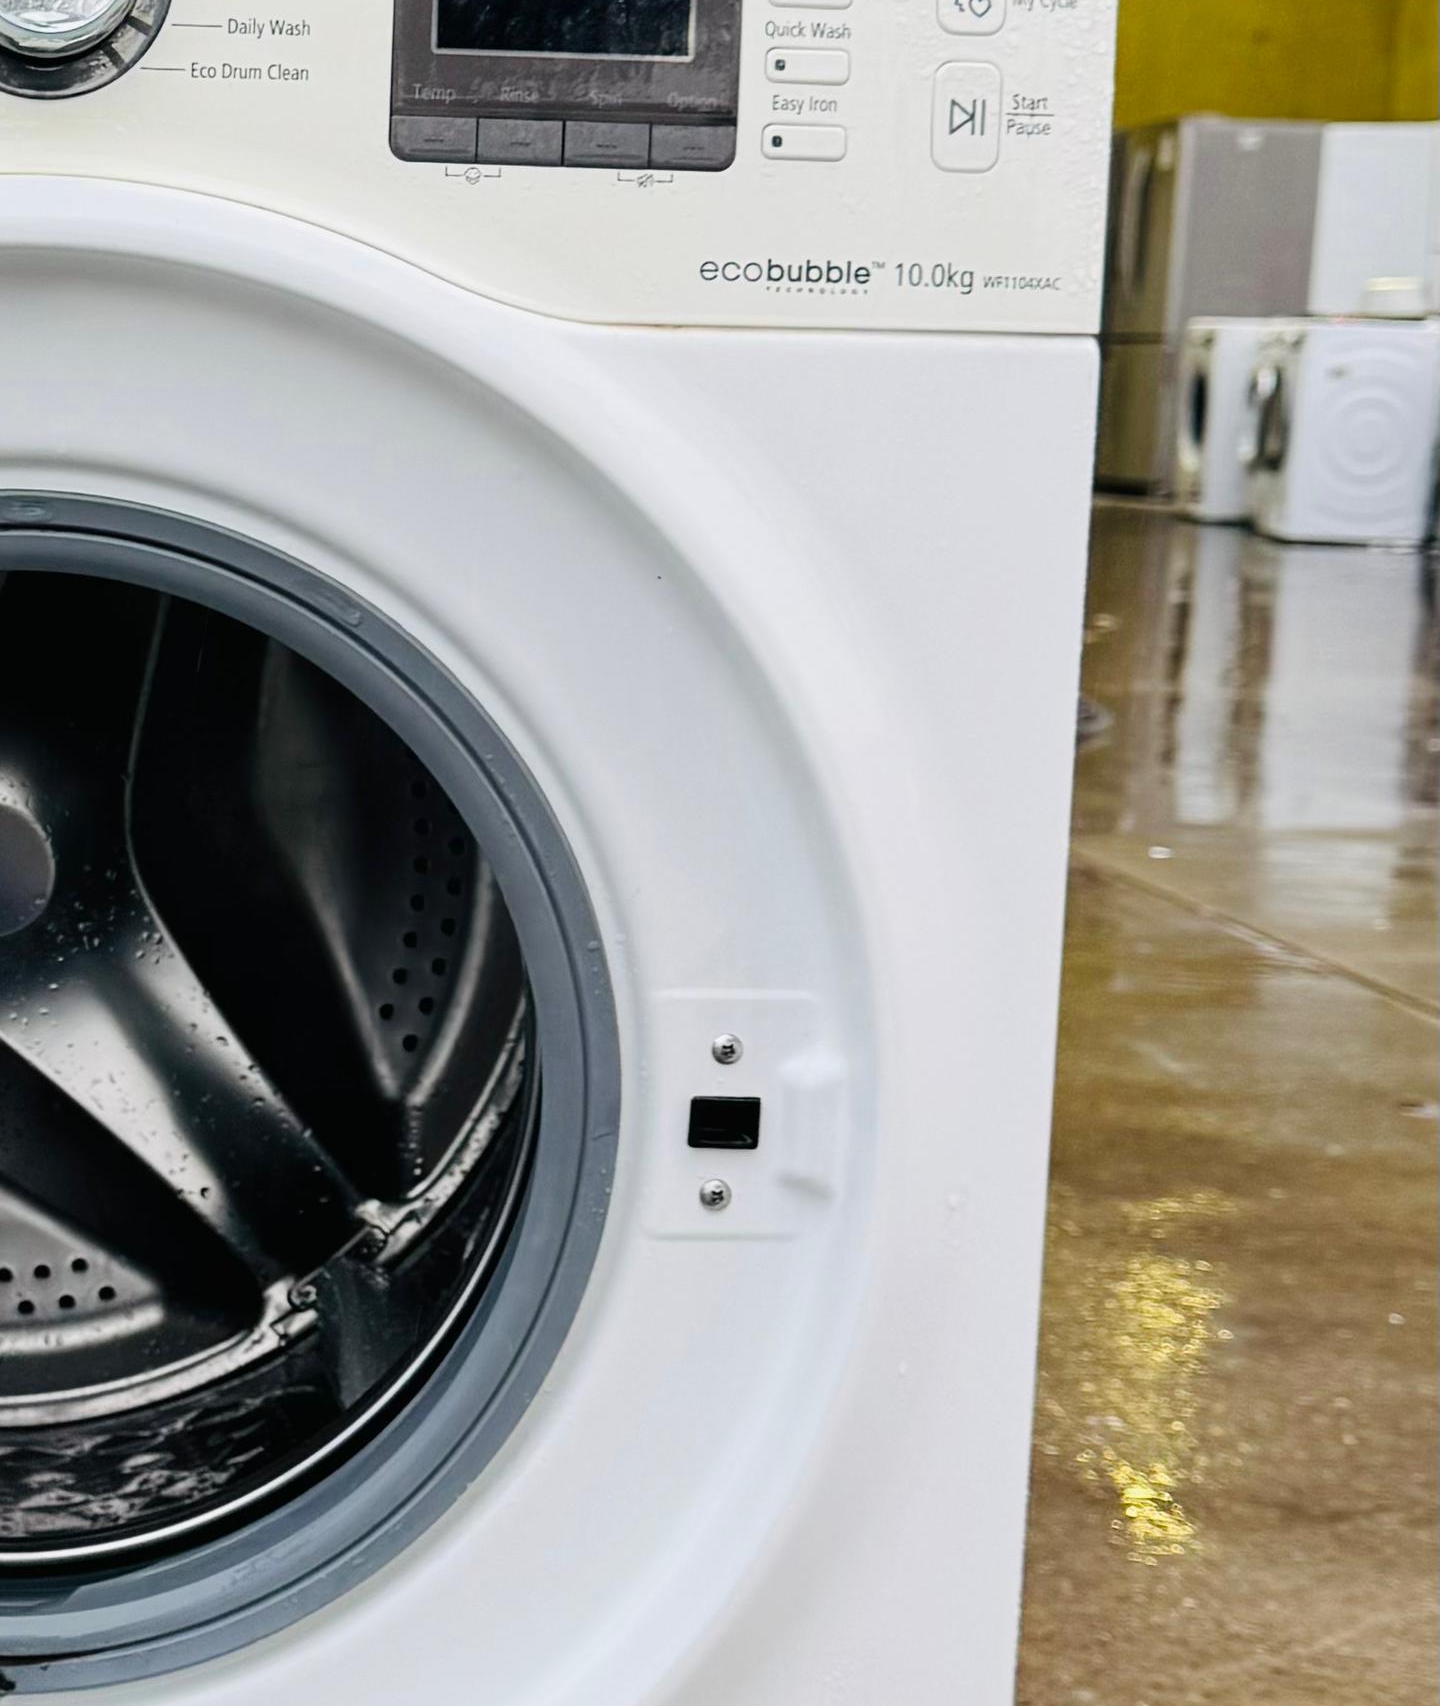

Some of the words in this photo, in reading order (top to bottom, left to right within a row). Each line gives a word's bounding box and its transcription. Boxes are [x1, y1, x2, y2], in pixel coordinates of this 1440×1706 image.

[228, 17, 265, 39] Daily
[269, 19, 310, 36] Wash
[765, 20, 806, 39] Quick
[811, 22, 852, 39] Wash
[191, 62, 217, 78] Eco
[221, 63, 262, 80] Drum
[267, 63, 309, 81] Clean
[413, 83, 456, 103] Temp
[1012, 93, 1048, 112] Start
[772, 94, 805, 115] Easy
[809, 96, 837, 112] Iron
[1006, 117, 1052, 138] Pause
[894, 262, 975, 295] 10.0kg
